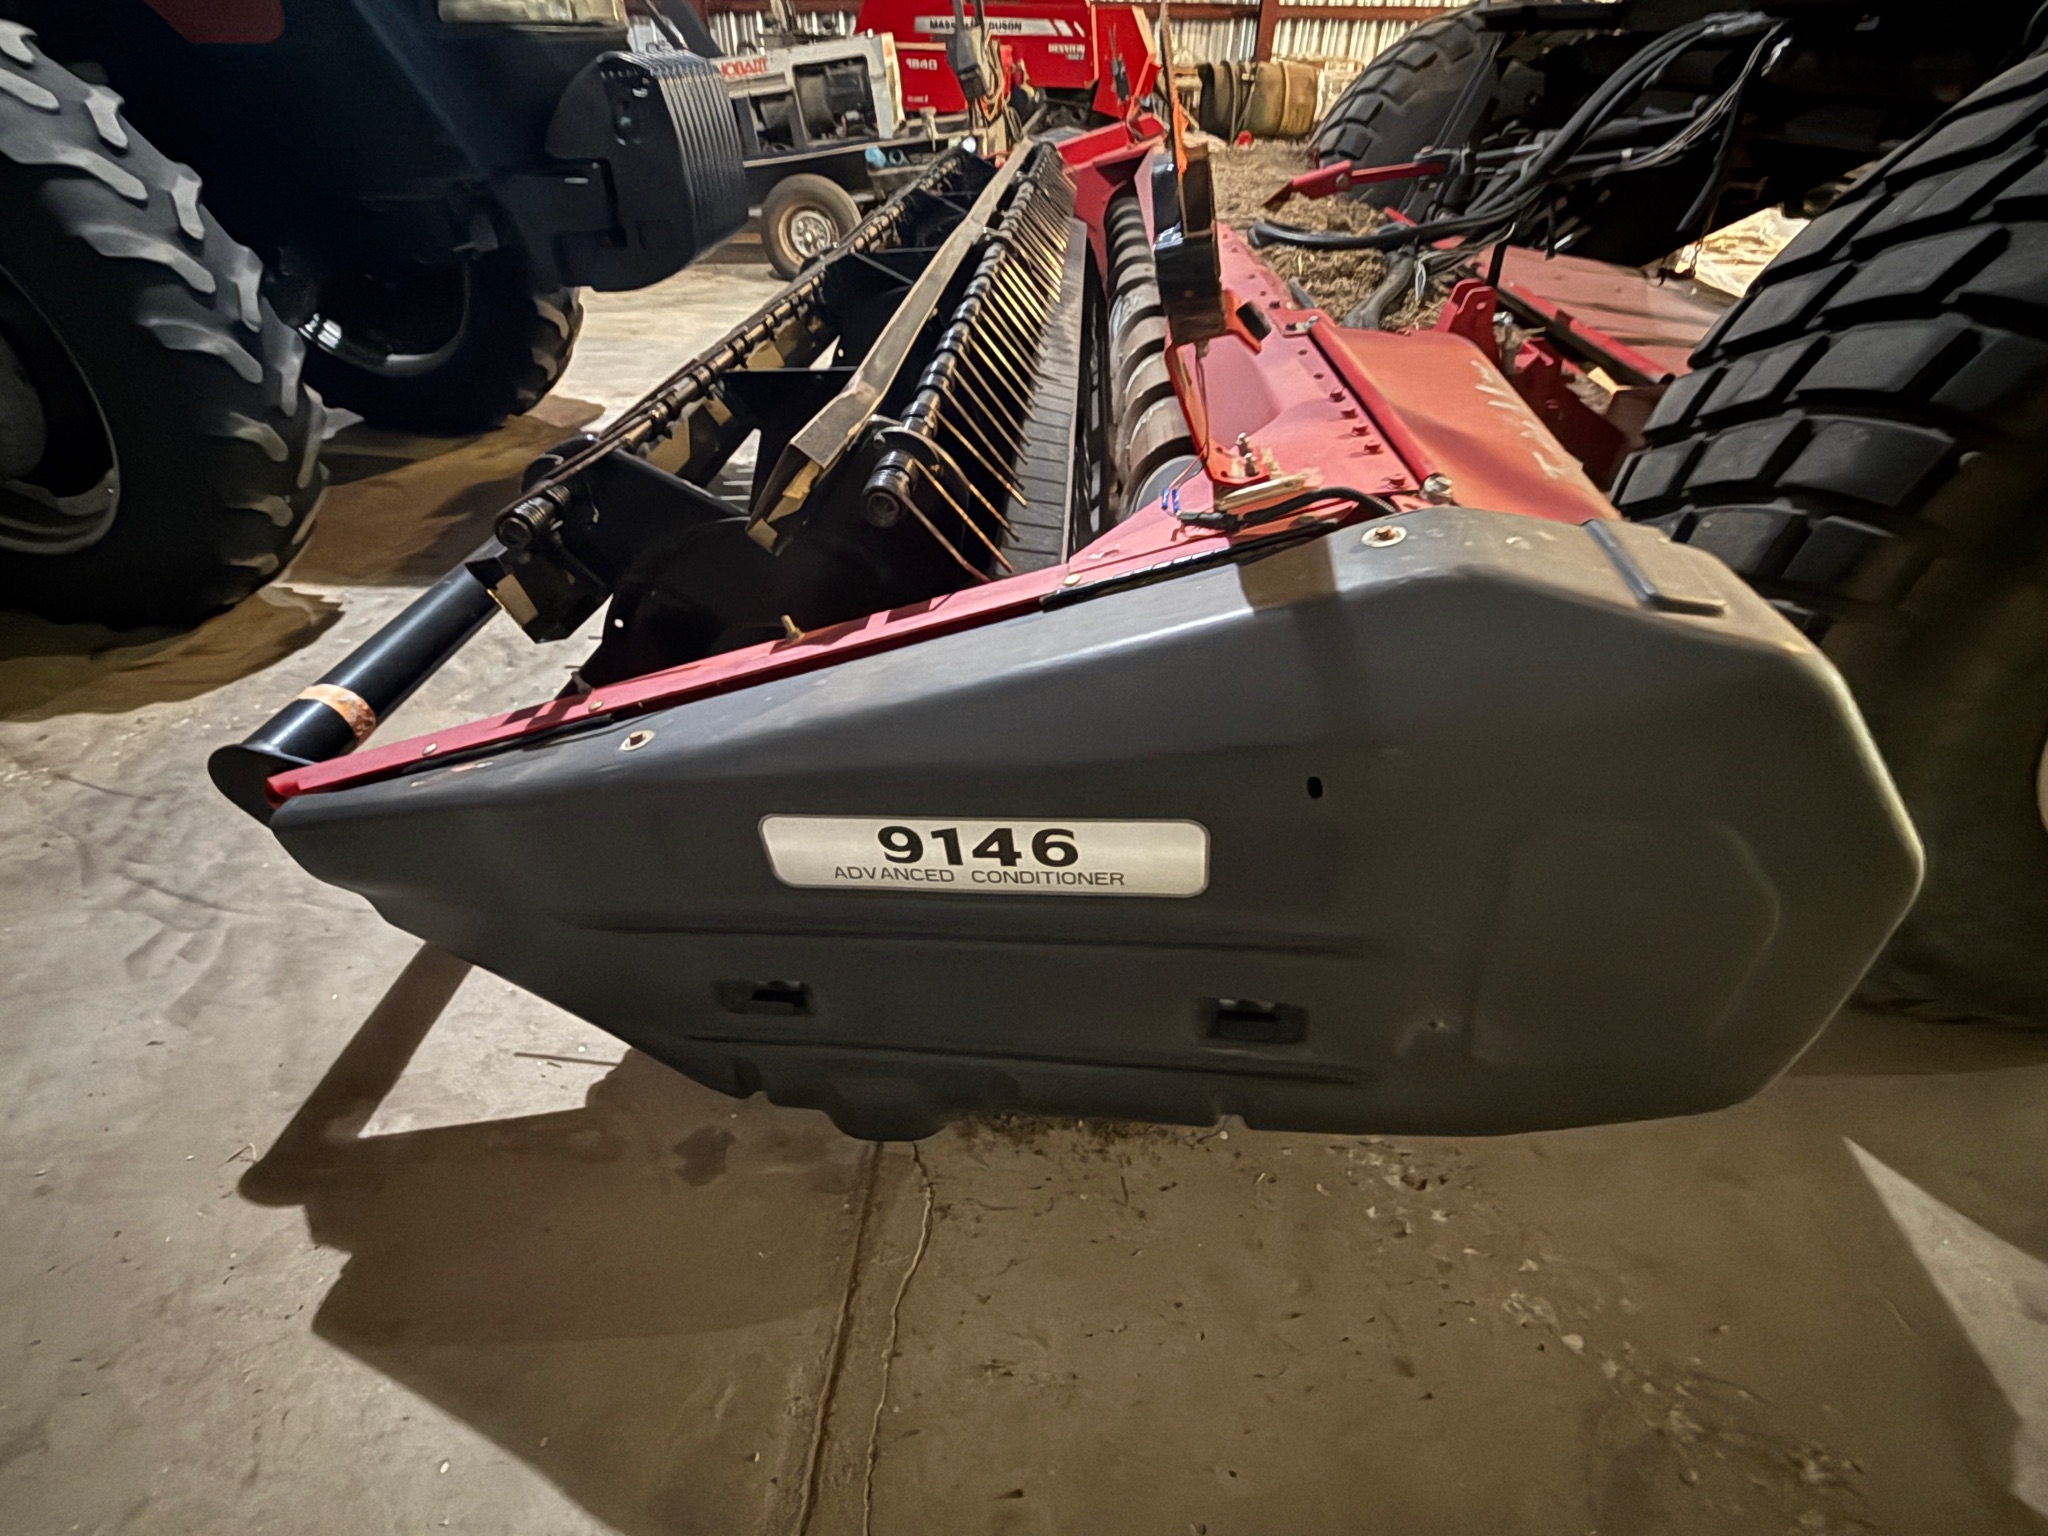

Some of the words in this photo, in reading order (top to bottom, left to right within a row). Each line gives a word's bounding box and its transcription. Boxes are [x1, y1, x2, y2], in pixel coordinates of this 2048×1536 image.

[877, 825, 1079, 867] 9146
[834, 866, 955, 882] ADVANCED
[971, 870, 1125, 886] CONDITIONER
